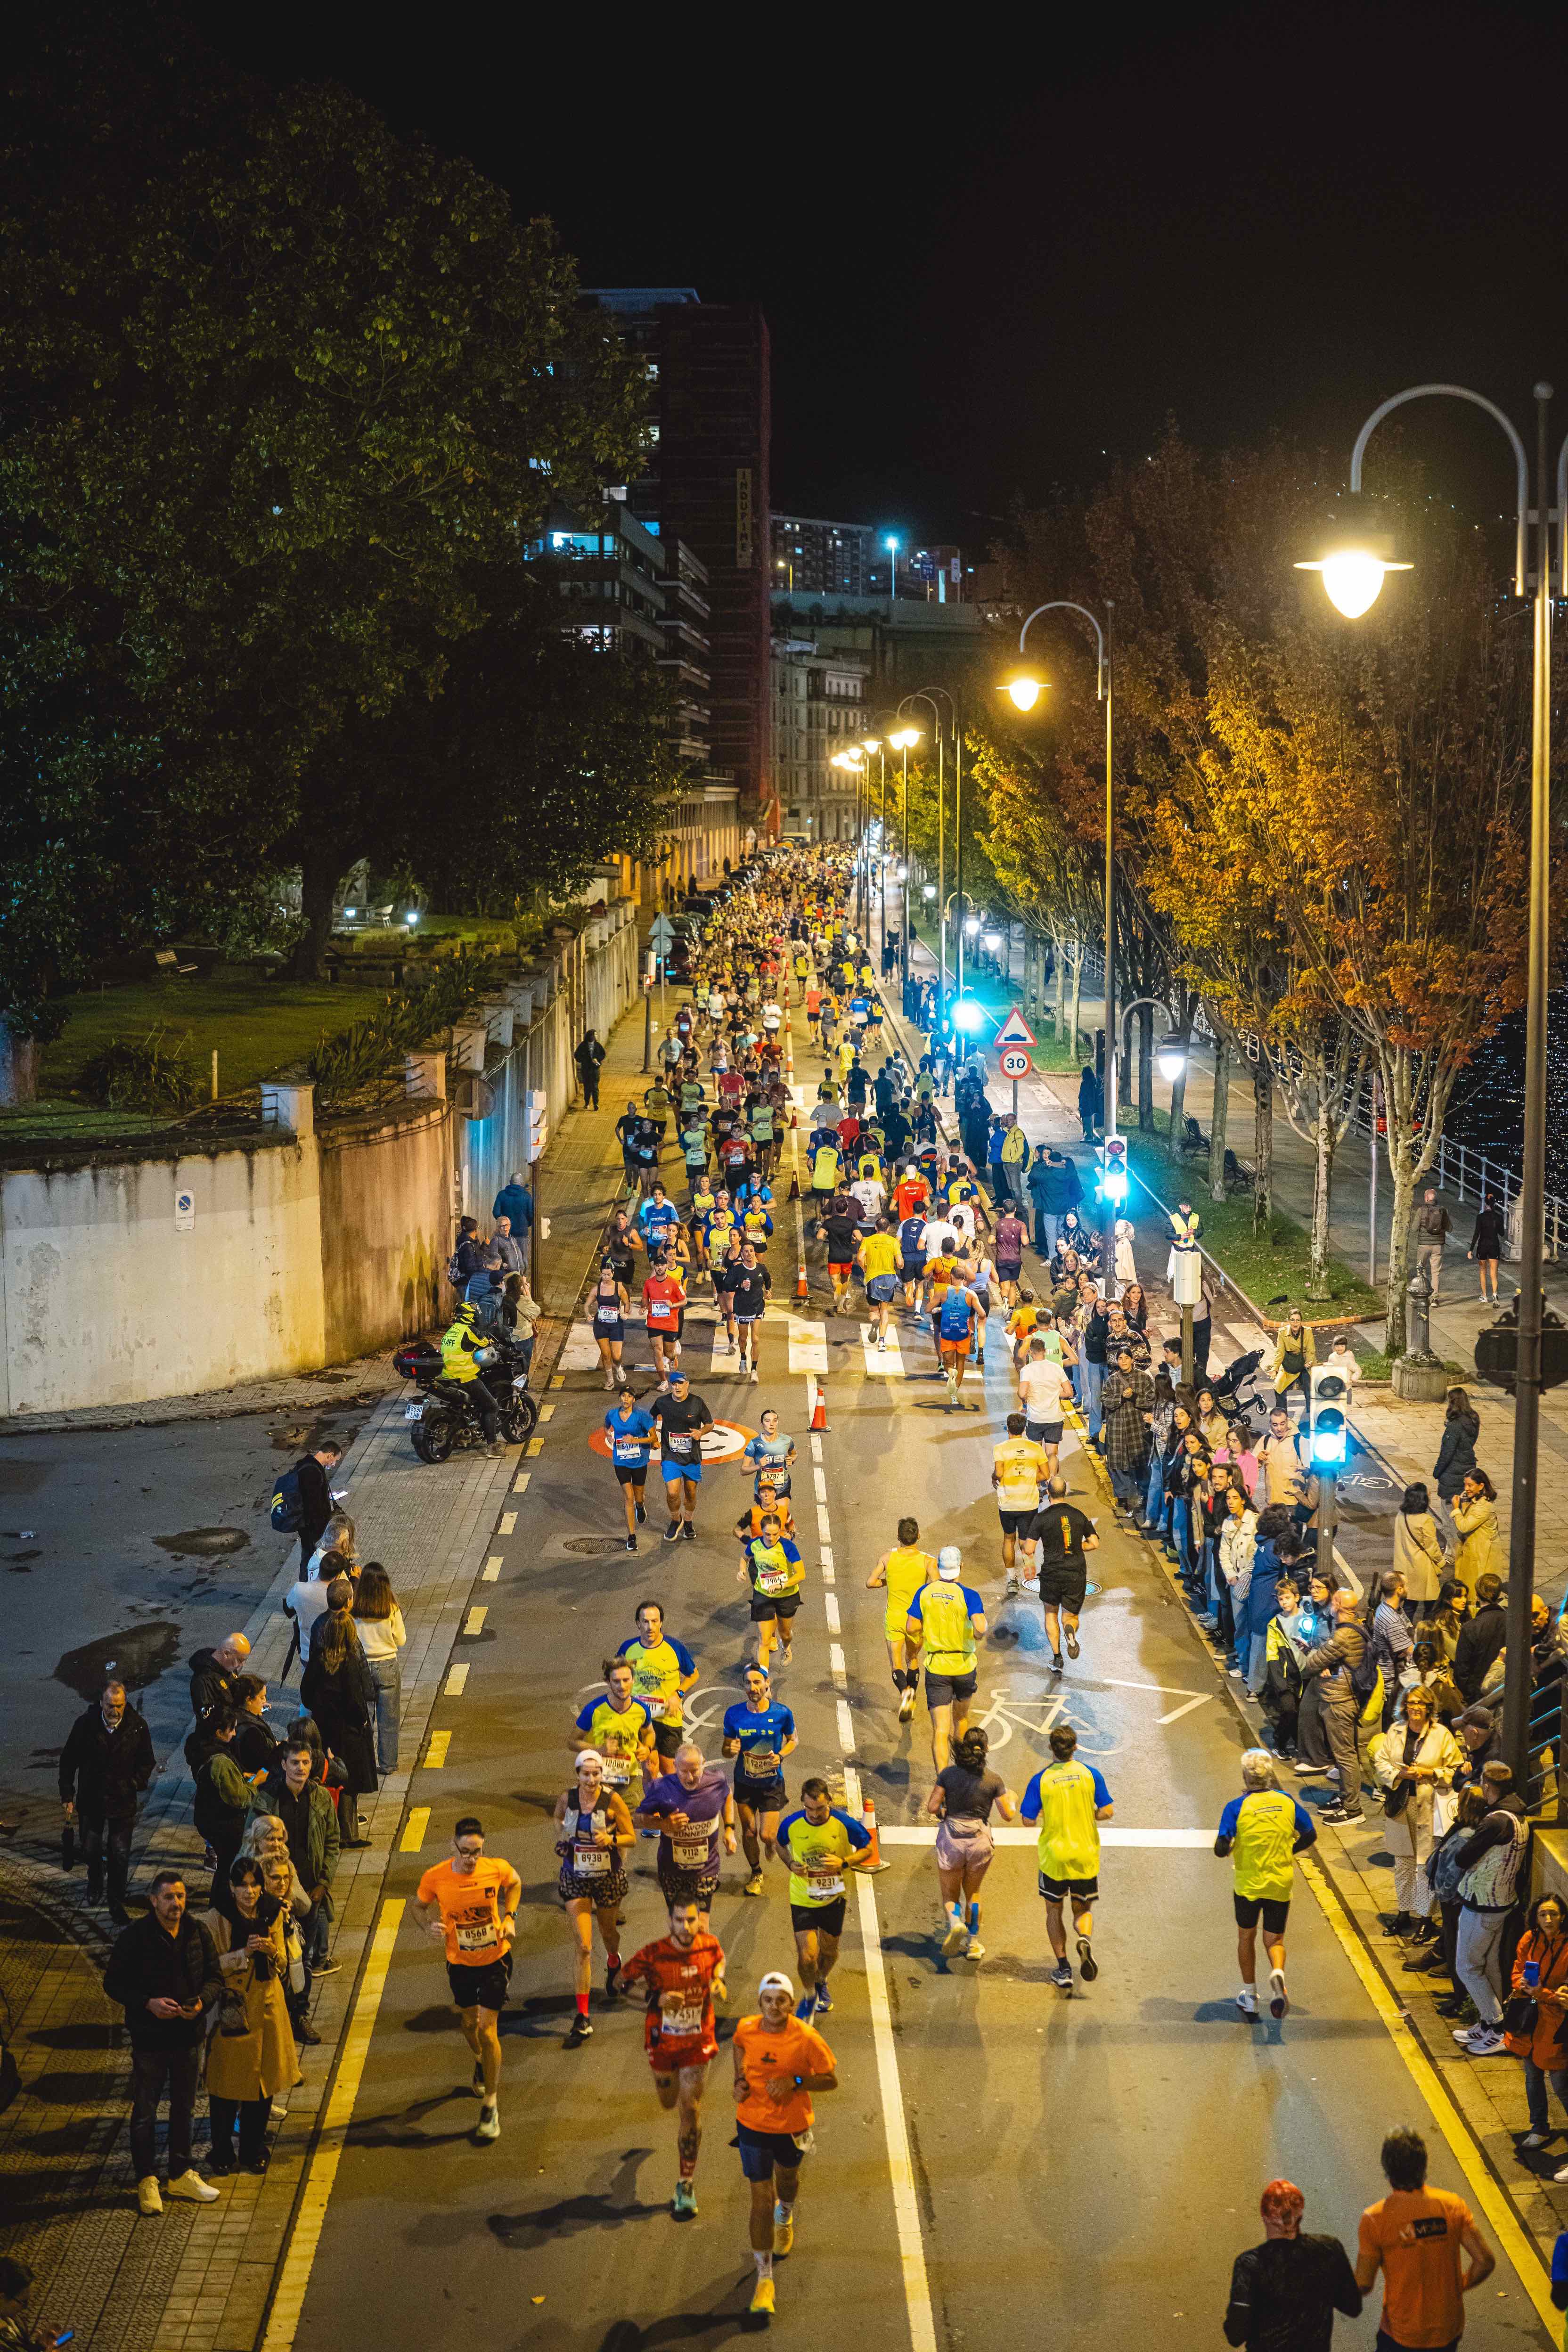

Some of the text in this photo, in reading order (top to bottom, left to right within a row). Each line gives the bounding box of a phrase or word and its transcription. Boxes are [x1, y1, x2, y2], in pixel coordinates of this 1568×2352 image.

[1007, 1058, 1025, 1069] 30
[442, 1338, 455, 1347] STAFF
[682, 1848, 699, 1856] 9112
[581, 1854, 602, 1862] 8938
[817, 1878, 835, 1886] 9231
